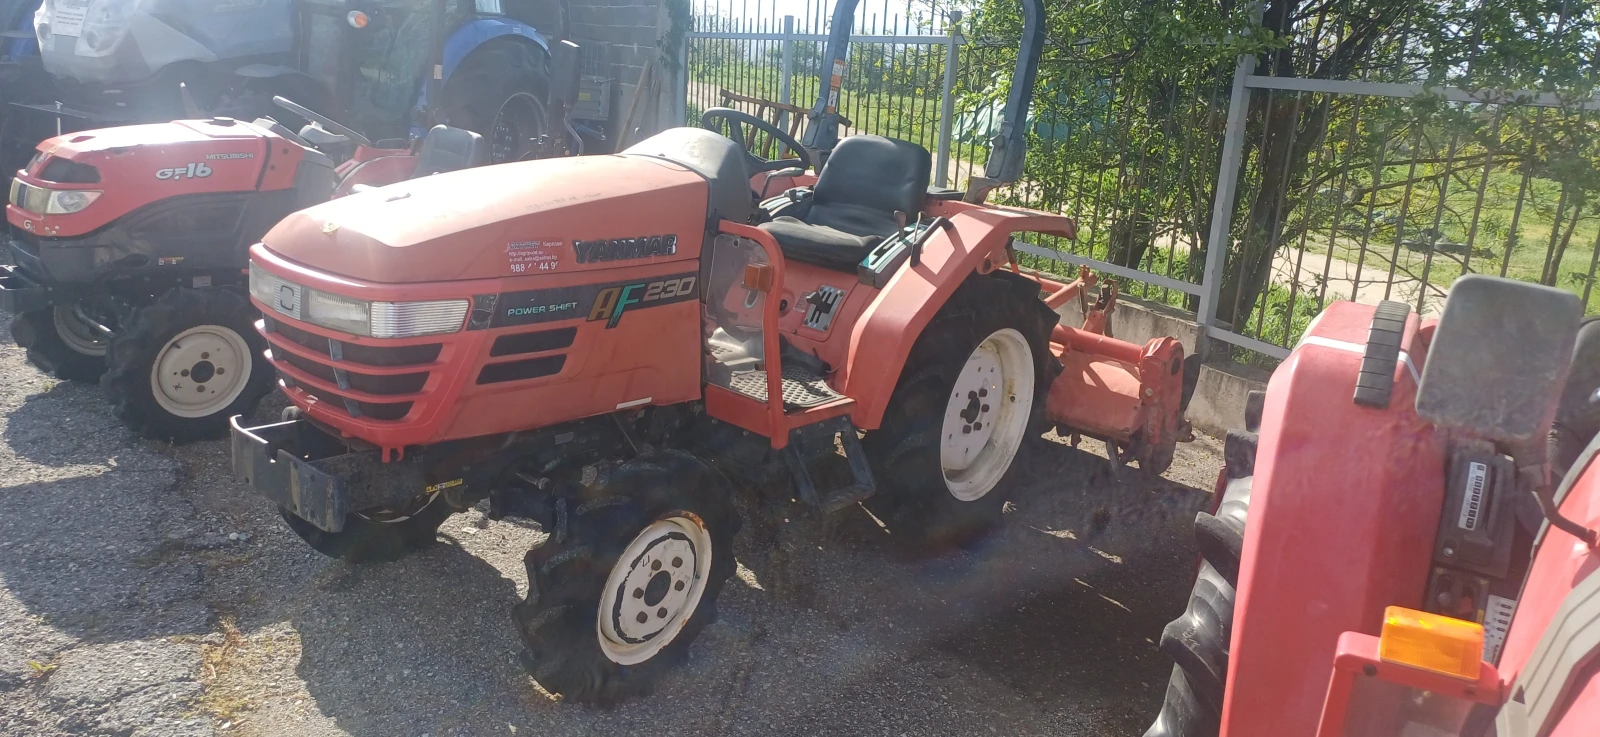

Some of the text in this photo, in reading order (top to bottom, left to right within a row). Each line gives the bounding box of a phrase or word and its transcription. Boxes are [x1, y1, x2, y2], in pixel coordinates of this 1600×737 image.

[205, 152, 254, 160] MITSUBISHI
[155, 162, 212, 180] GF16
[572, 235, 678, 264] YANMAR
[507, 301, 579, 317] POWER SHIFT
